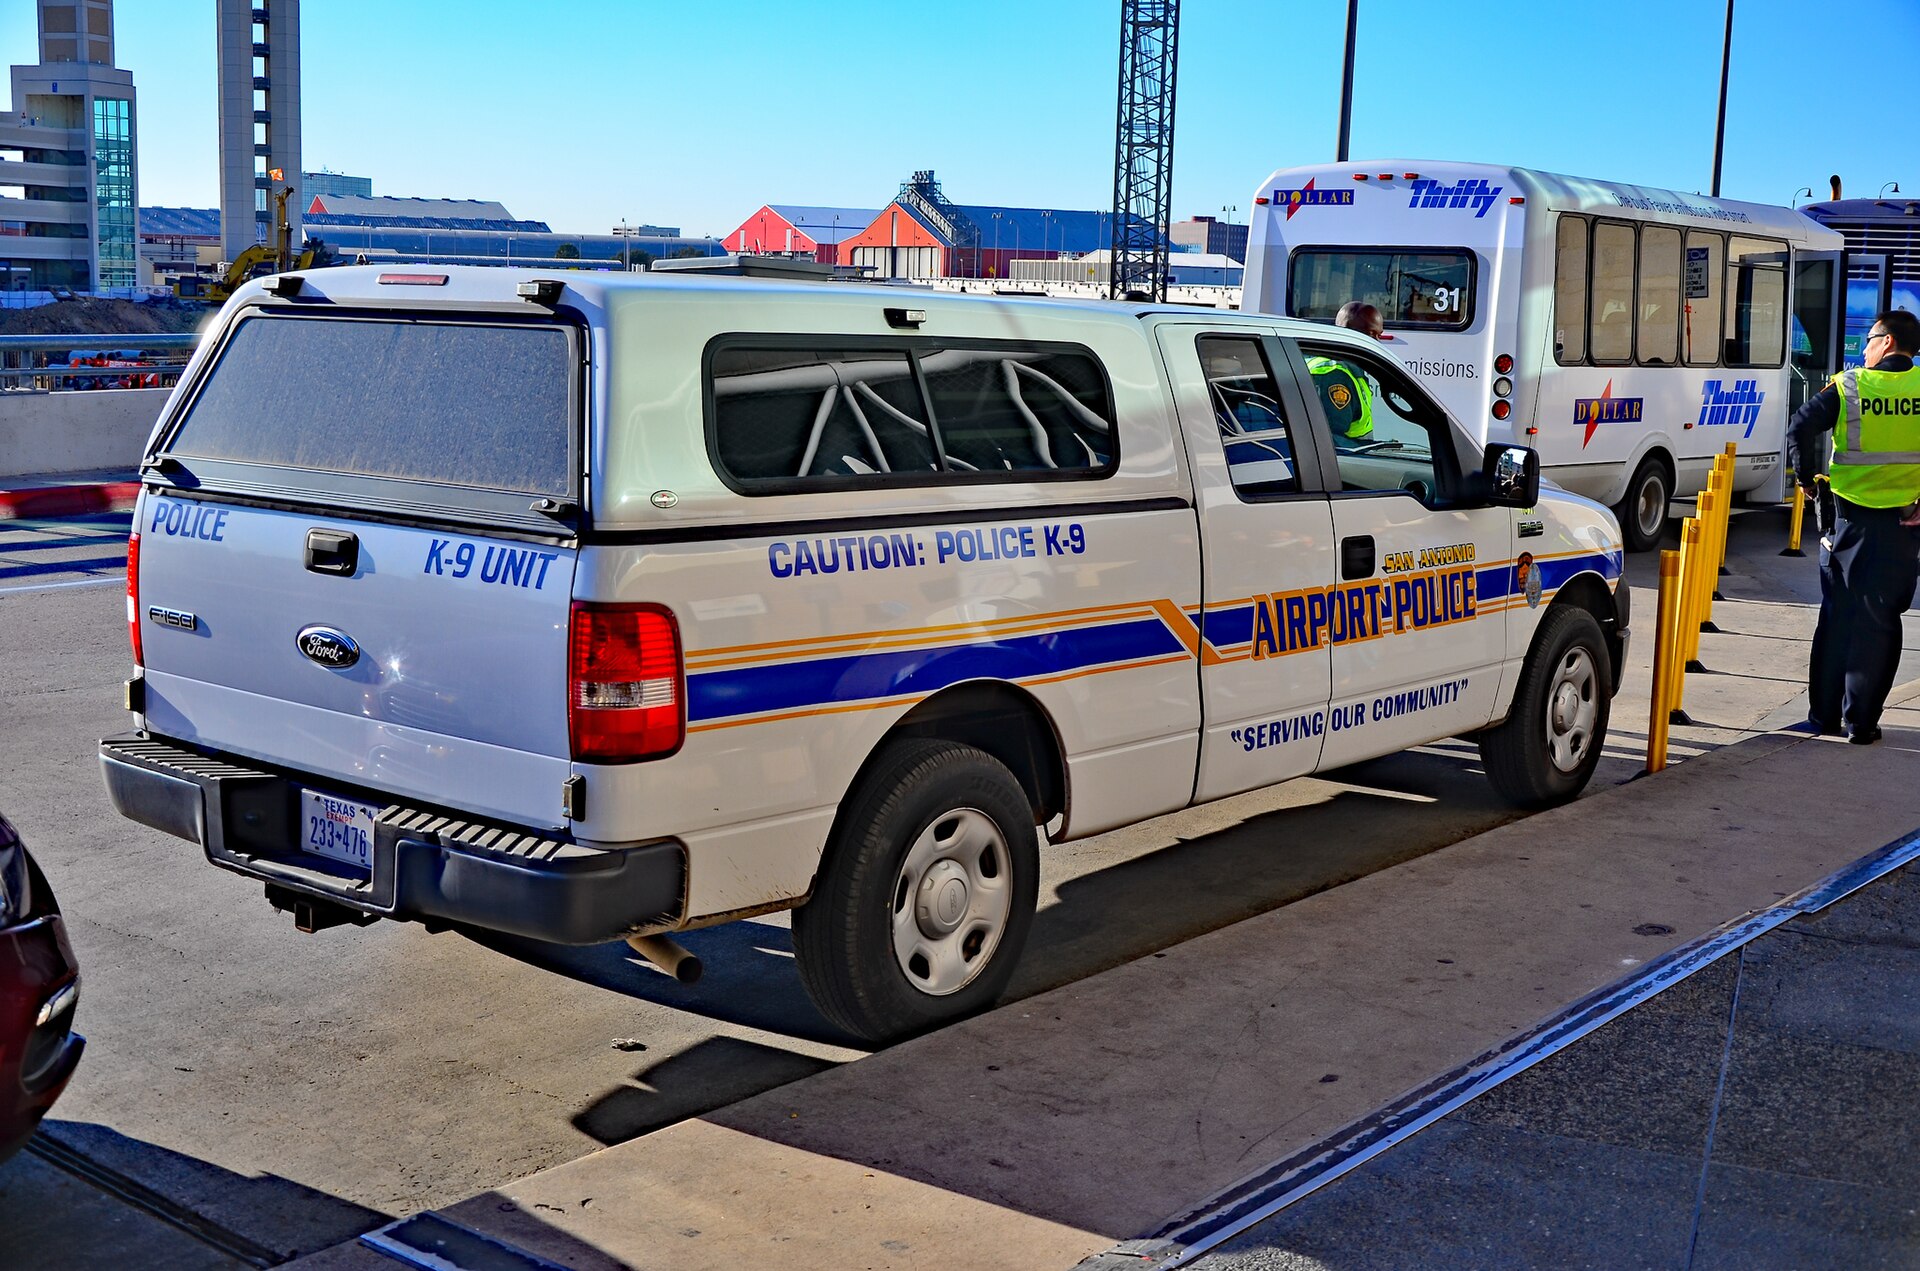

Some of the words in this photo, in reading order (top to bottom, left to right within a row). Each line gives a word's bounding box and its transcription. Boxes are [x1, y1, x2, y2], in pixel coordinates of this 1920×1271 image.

[1276, 190, 1352, 204] DOLLAR
[1409, 180, 1503, 218] Thrifty
[1433, 287, 1460, 312] 31
[1405, 358, 1478, 379] missions.
[1576, 400, 1642, 422] DOLLAR
[1698, 380, 1765, 438] Thrifty
[1861, 398, 1920, 416] POLICE
[151, 502, 229, 542] POLICE
[768, 533, 925, 578] CAUTION:
[935, 526, 1036, 564] POLICE
[1043, 523, 1086, 556] K-9
[1383, 551, 1415, 573] SAN
[1418, 543, 1475, 568] ANTONIO
[424, 540, 475, 578] K-9
[481, 545, 559, 590] UNIT
[1252, 578, 1384, 661] AIRPORT
[1389, 565, 1477, 635] POLICE
[306, 633, 340, 661] Ford
[1331, 703, 1366, 731] OUR
[324, 798, 355, 818] TEXAS
[326, 811, 353, 824] EXEMPT
